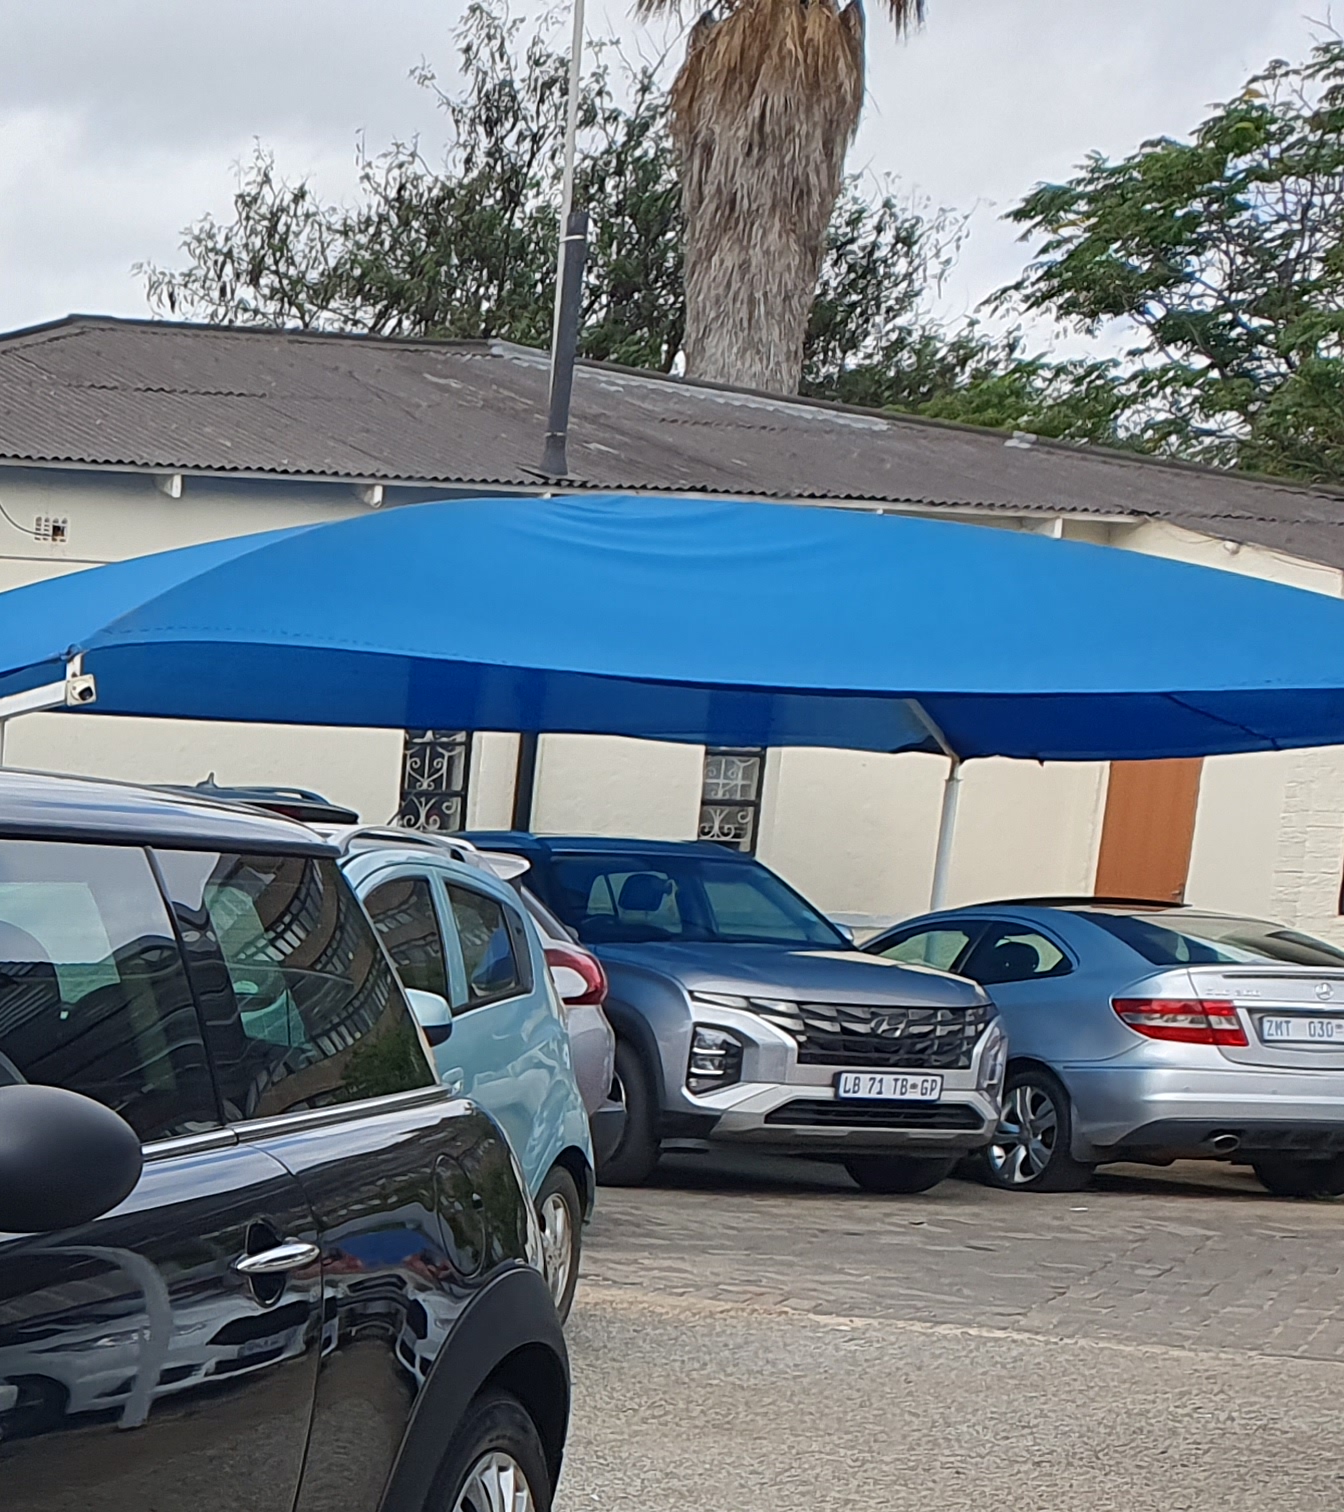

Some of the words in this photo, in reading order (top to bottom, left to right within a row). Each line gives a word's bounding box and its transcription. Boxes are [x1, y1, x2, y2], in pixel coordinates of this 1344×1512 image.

[1308, 1020, 1334, 1038] 030
[842, 1075, 861, 1095] LB
[868, 1076, 884, 1096] 71
[892, 1077, 909, 1097] TB
[920, 1078, 938, 1097] GP
